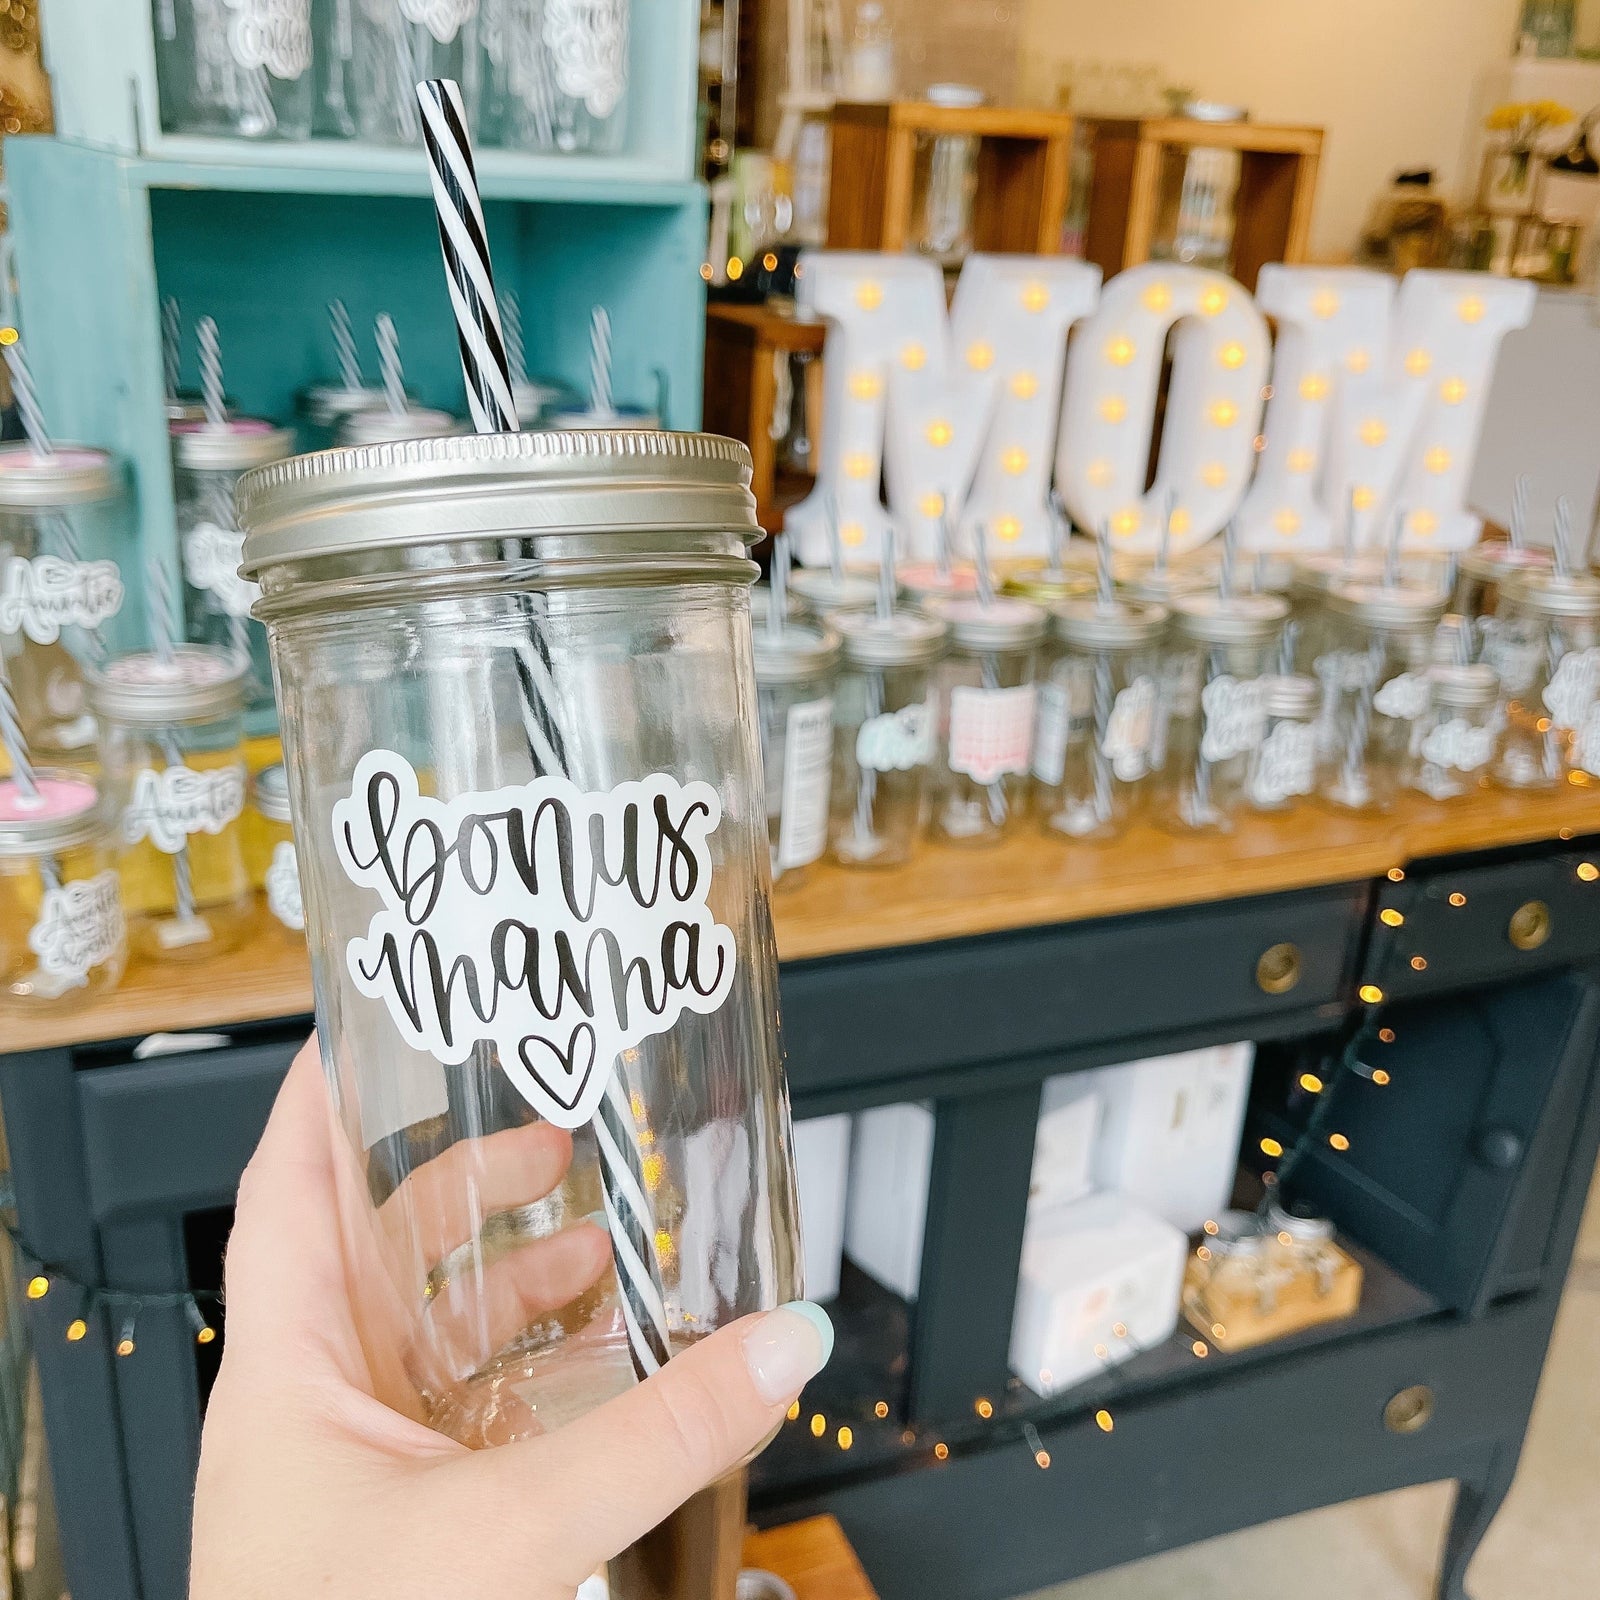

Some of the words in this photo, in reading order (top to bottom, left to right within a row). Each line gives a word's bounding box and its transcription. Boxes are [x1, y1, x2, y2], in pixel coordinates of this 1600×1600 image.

[784, 252, 1537, 566] MOM
[345, 771, 709, 925] bonus
[359, 918, 724, 1047] mama
